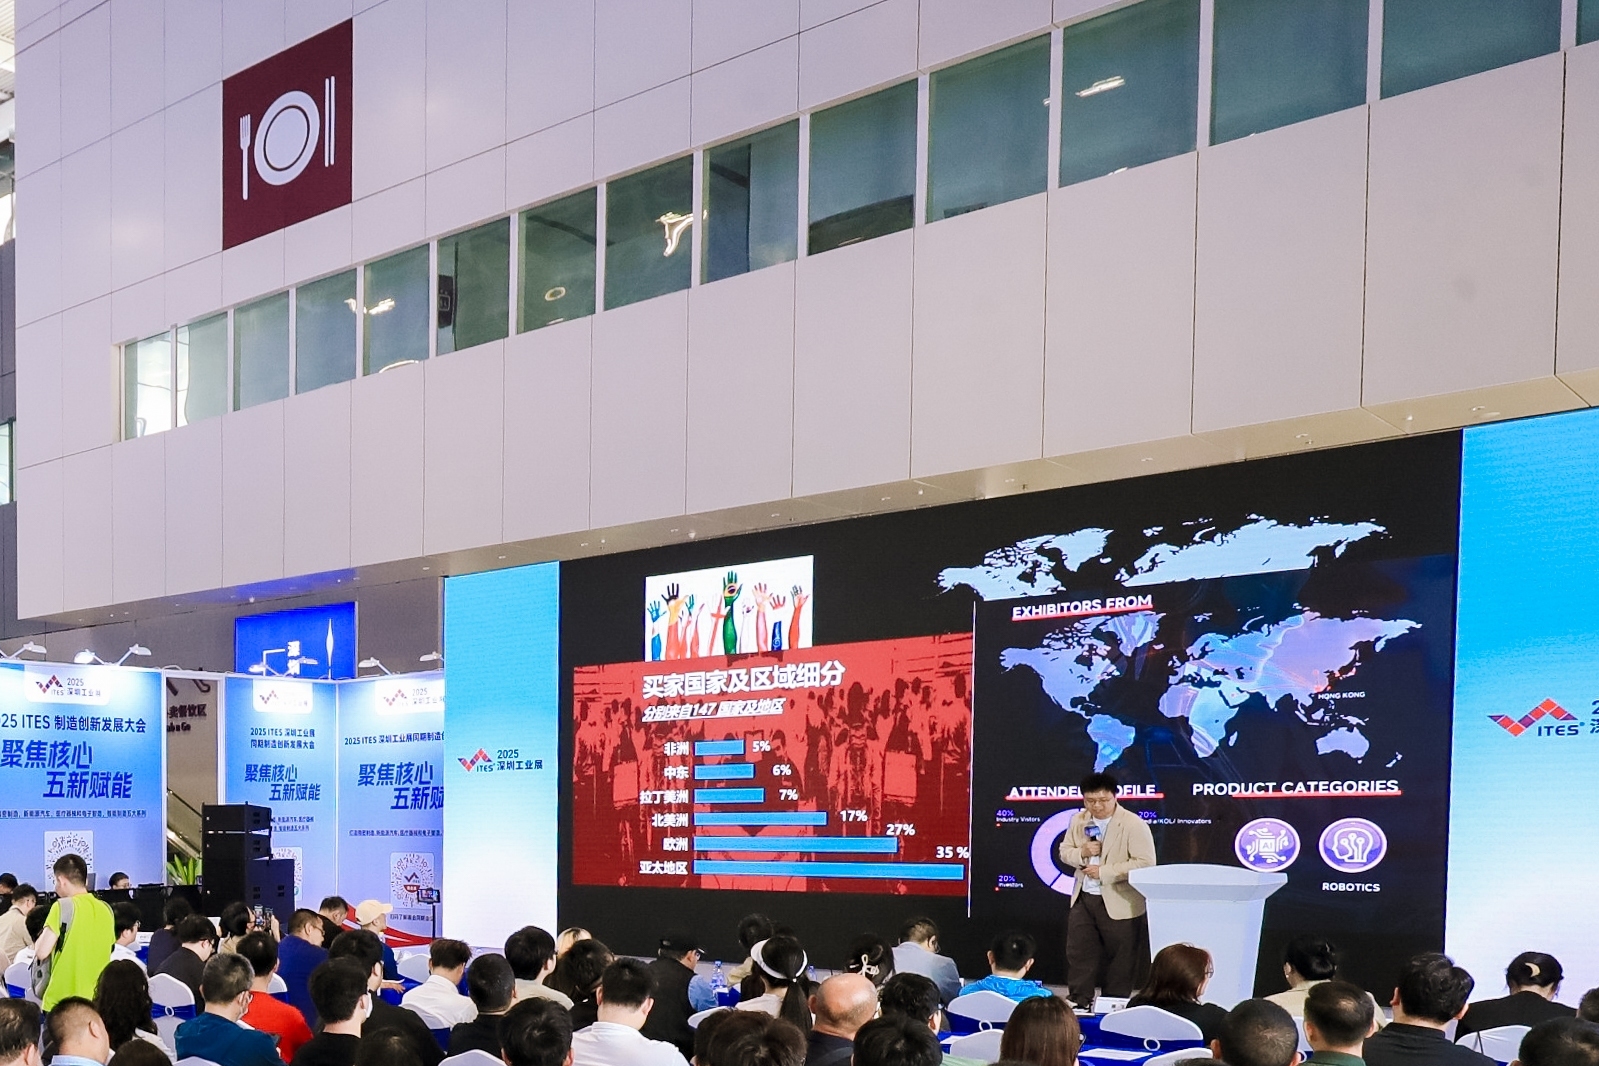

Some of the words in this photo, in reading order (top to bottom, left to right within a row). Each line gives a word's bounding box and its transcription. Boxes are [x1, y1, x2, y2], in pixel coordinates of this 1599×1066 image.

[1012, 599, 1102, 618] EXHIBITORS
[1105, 594, 1153, 609] FROM
[67, 677, 84, 687] 2025
[642, 659, 846, 699] 买家国家及区域细分
[167, 704, 207, 718] 卖餐饮区
[22, 714, 50, 729] ITES
[54, 715, 146, 733] 制造创新发展大会
[1538, 725, 1579, 736] ITES
[250, 727, 266, 736] 2025
[268, 727, 282, 736] ITES
[285, 728, 315, 737] 深圳工业展
[250, 739, 315, 749] 同期制造创新发展大会
[345, 737, 361, 745] 2025
[362, 736, 377, 744] ITES
[663, 741, 690, 756] 非洲
[752, 740, 771, 752] 5%
[0, 739, 93, 769] 聚焦核心
[497, 749, 519, 759] 2025
[244, 763, 298, 783] 聚焦核心
[497, 760, 543, 770] 深圳工业展
[663, 766, 690, 780] 中东
[772, 764, 792, 776] 6%
[357, 761, 434, 786] 聚焦核心
[43, 771, 133, 799] 五新赋能
[269, 783, 321, 801] 五新赋能
[1192, 782, 1276, 796] PRODUCT
[1281, 780, 1399, 794] CATEGORIES
[640, 789, 689, 804] 拉丁美洲
[779, 789, 798, 801] 7%
[651, 813, 689, 827] 北美洲
[840, 810, 868, 822] 17%
[663, 837, 689, 851] 欧洲
[886, 823, 916, 836] 27%
[639, 860, 688, 875] 亚太地区
[1322, 882, 1380, 892] ROBOTICS
